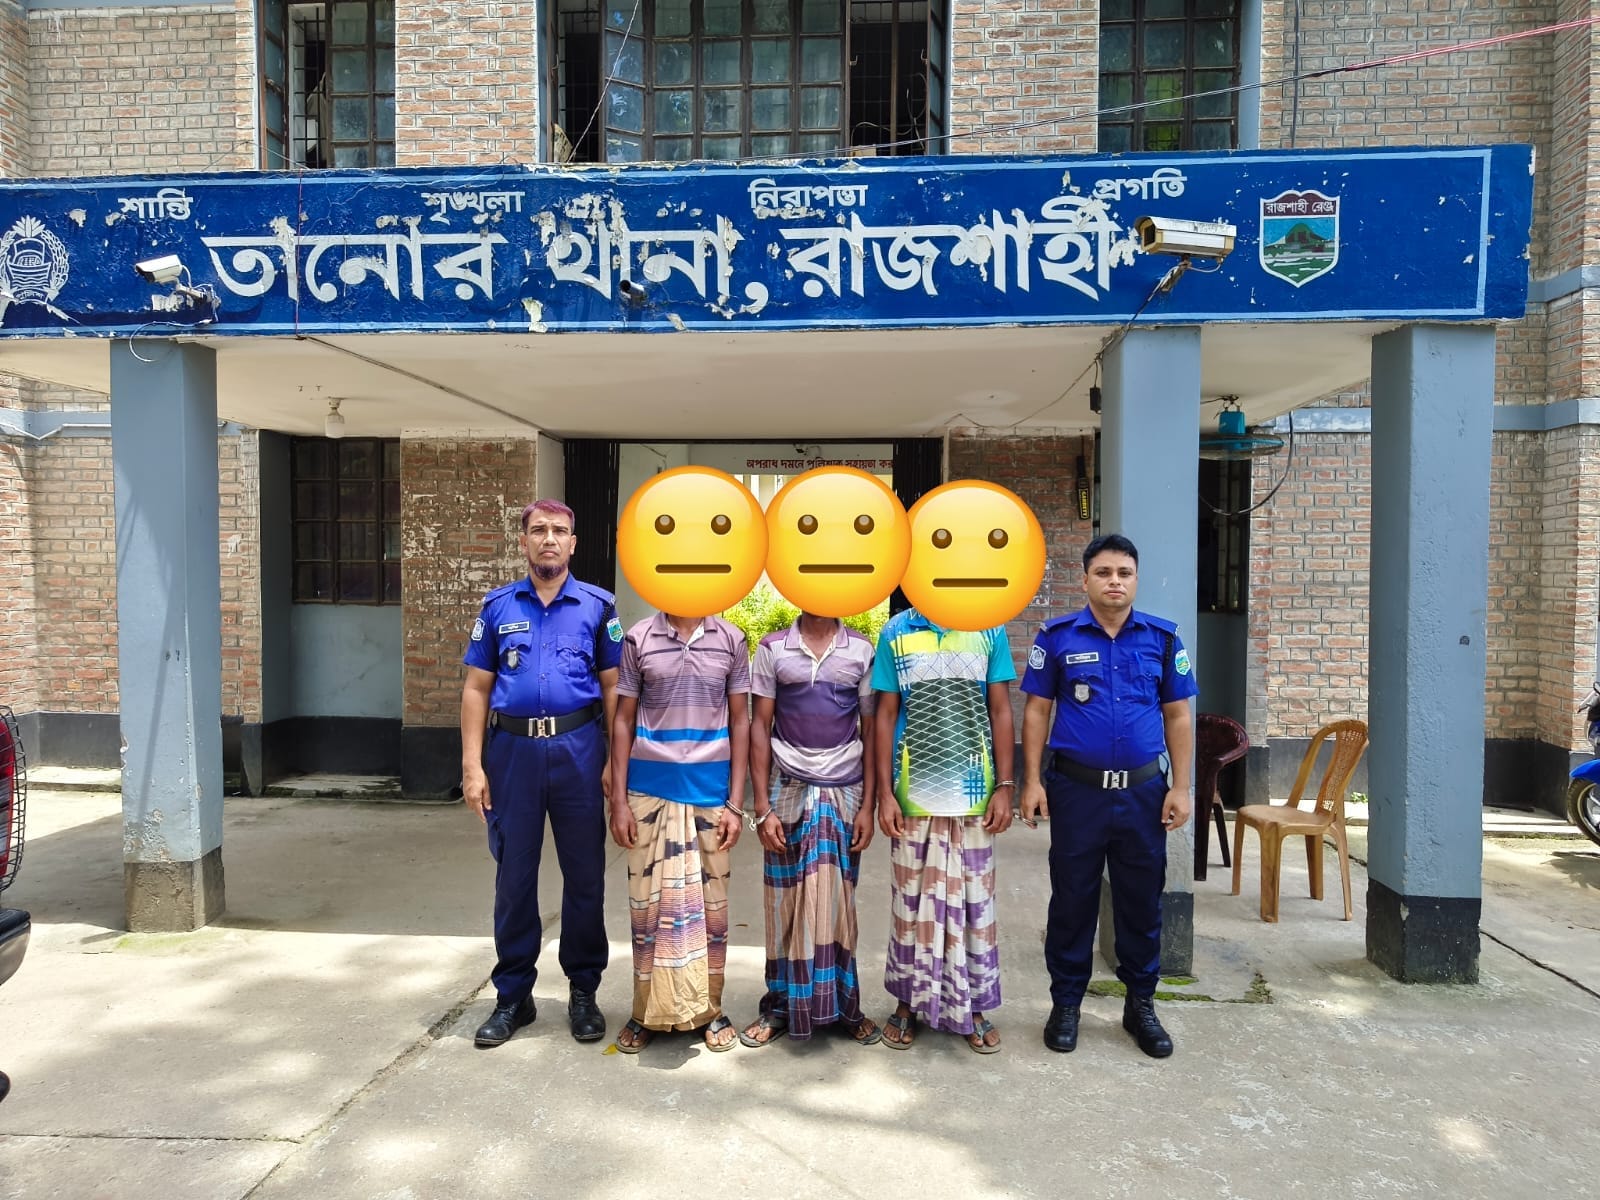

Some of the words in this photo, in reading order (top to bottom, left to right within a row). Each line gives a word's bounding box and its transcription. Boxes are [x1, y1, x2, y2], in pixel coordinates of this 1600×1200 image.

[118, 188, 193, 221] শান্তি
[421, 191, 525, 225] শৃঙ্খলা
[747, 178, 868, 208] নিরাপত্তা
[1094, 167, 1188, 201] প্রগতি
[1265, 199, 1309, 214] রাজশাহী
[1312, 200, 1335, 213] রেঞ্জ
[201, 225, 508, 302] তানোর
[779, 196, 1121, 301] রাজশাহী
[746, 459, 778, 468] অপরাধ
[780, 459, 805, 468] দমনে
